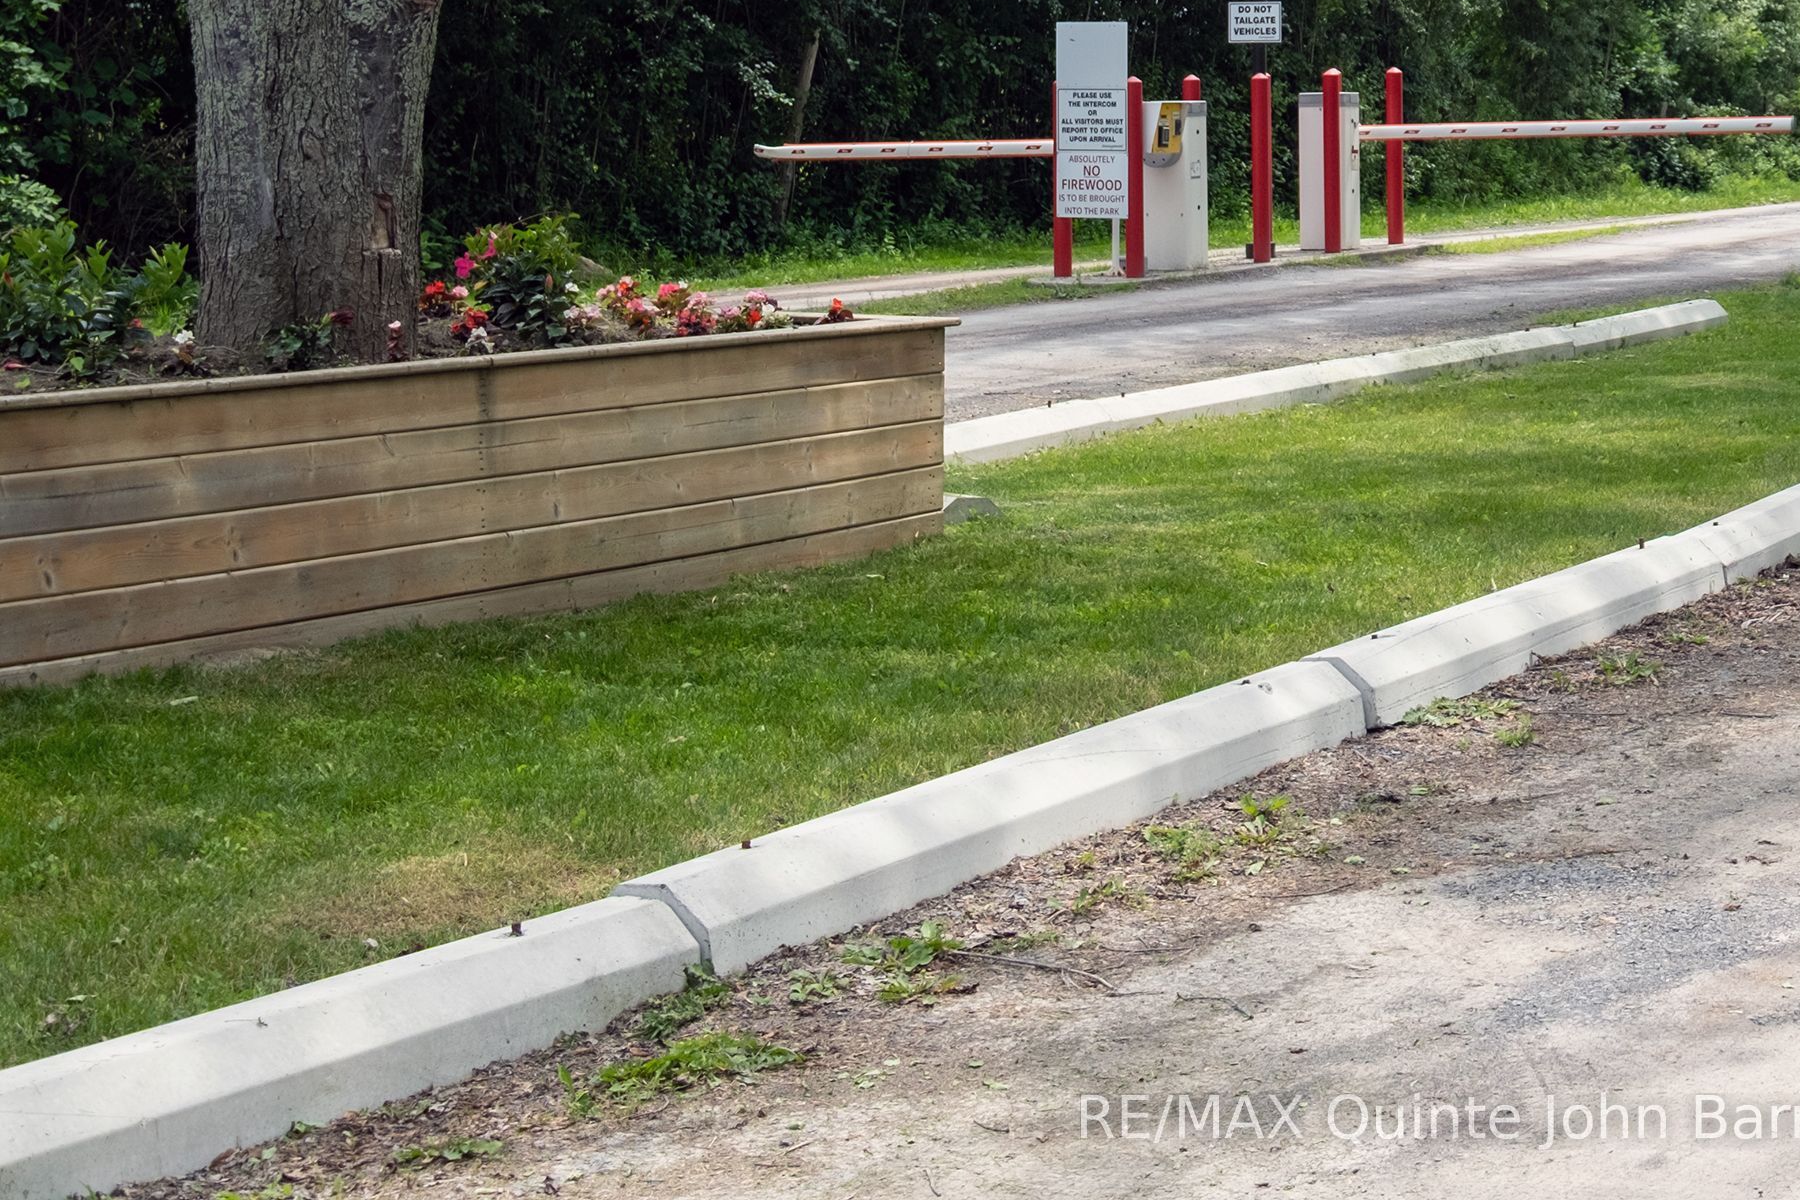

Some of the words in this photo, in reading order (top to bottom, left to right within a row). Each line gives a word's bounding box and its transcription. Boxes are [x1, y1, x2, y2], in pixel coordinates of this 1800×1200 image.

[1233, 27, 1277, 35] VEHICLES
[1069, 155, 1115, 163] ABSOLUTELY
[1083, 165, 1101, 176] NO
[1061, 179, 1122, 191] FIREWOOD
[1067, 194, 1078, 202] TO
[1079, 194, 1088, 202] BE
[1090, 195, 1125, 203] BROUGHT
[1064, 207, 1083, 215] INTO
[1084, 207, 1099, 215] THE
[1100, 208, 1120, 216] PARK
